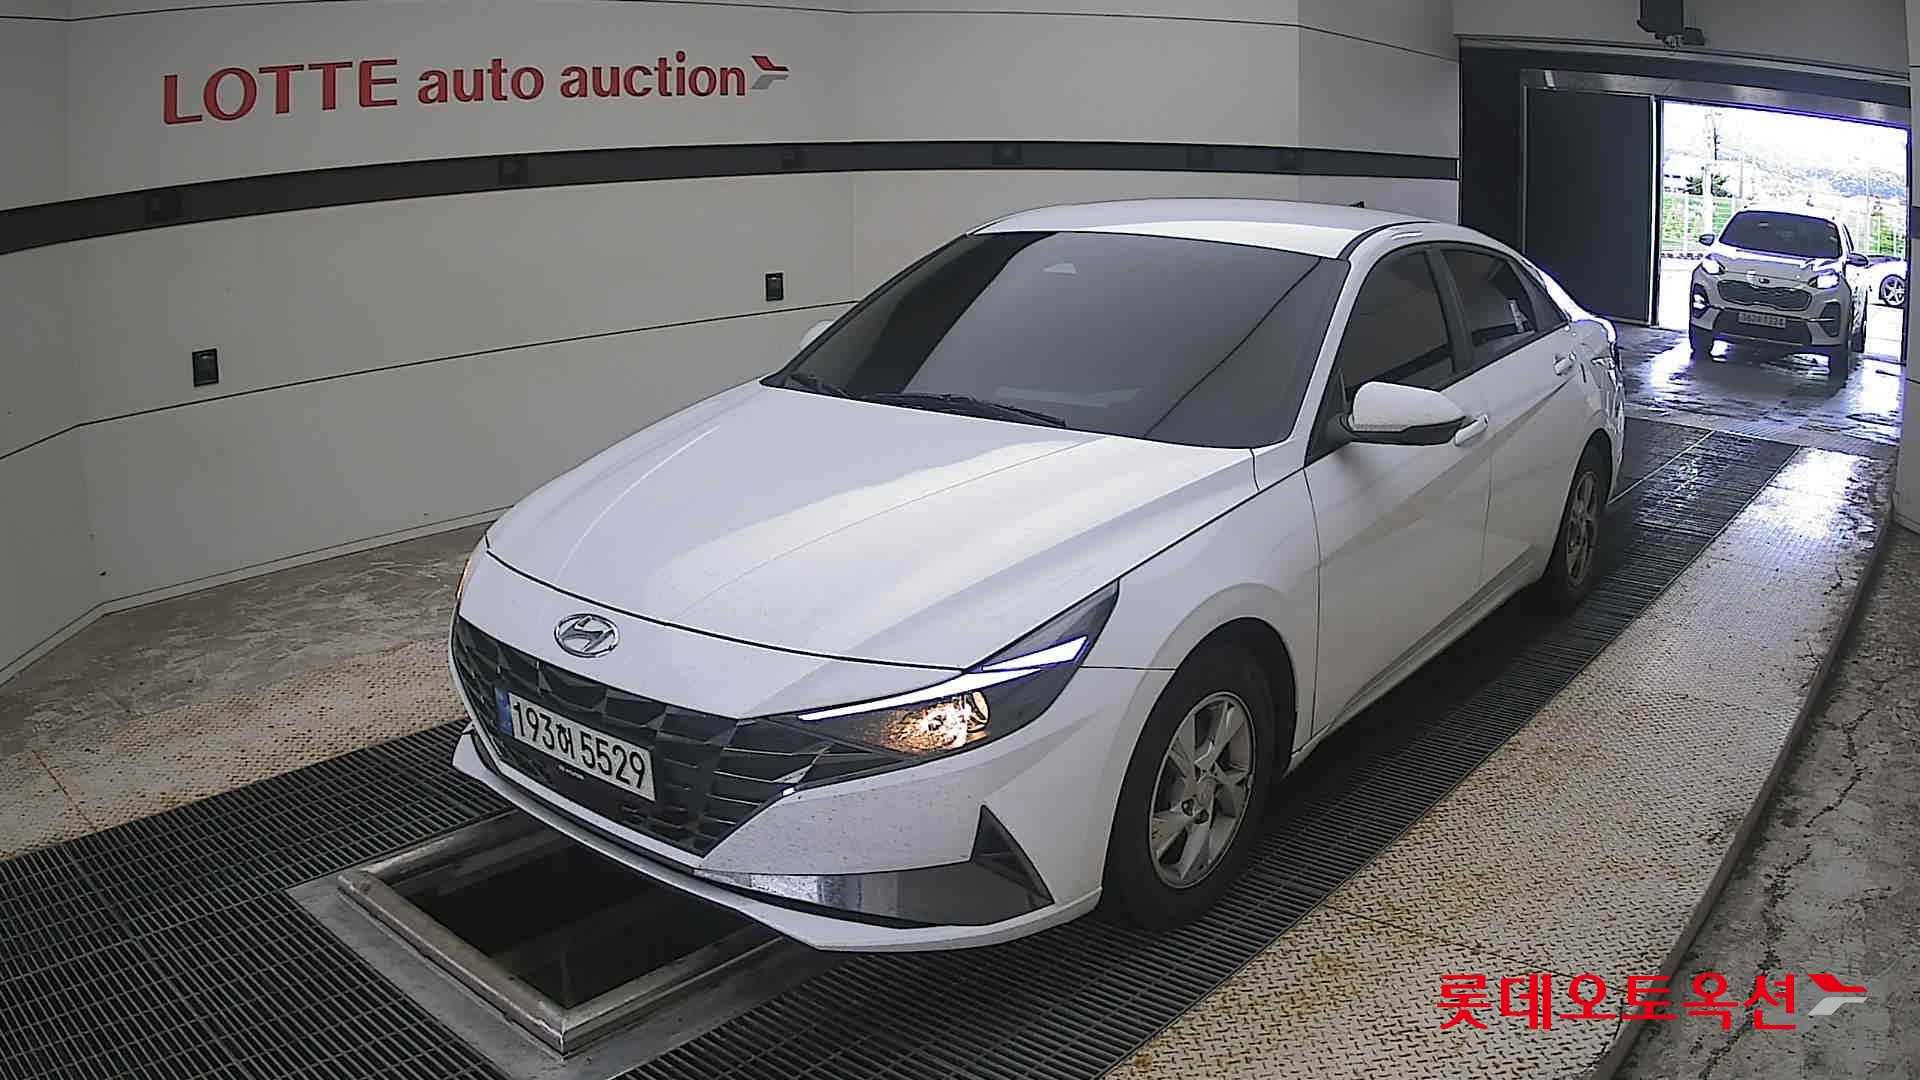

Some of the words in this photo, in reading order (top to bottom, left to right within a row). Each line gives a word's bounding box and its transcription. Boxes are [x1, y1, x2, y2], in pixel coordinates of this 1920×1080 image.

[164, 58, 398, 124] LOTTE
[418, 58, 544, 103] auto
[559, 51, 746, 97] auction
